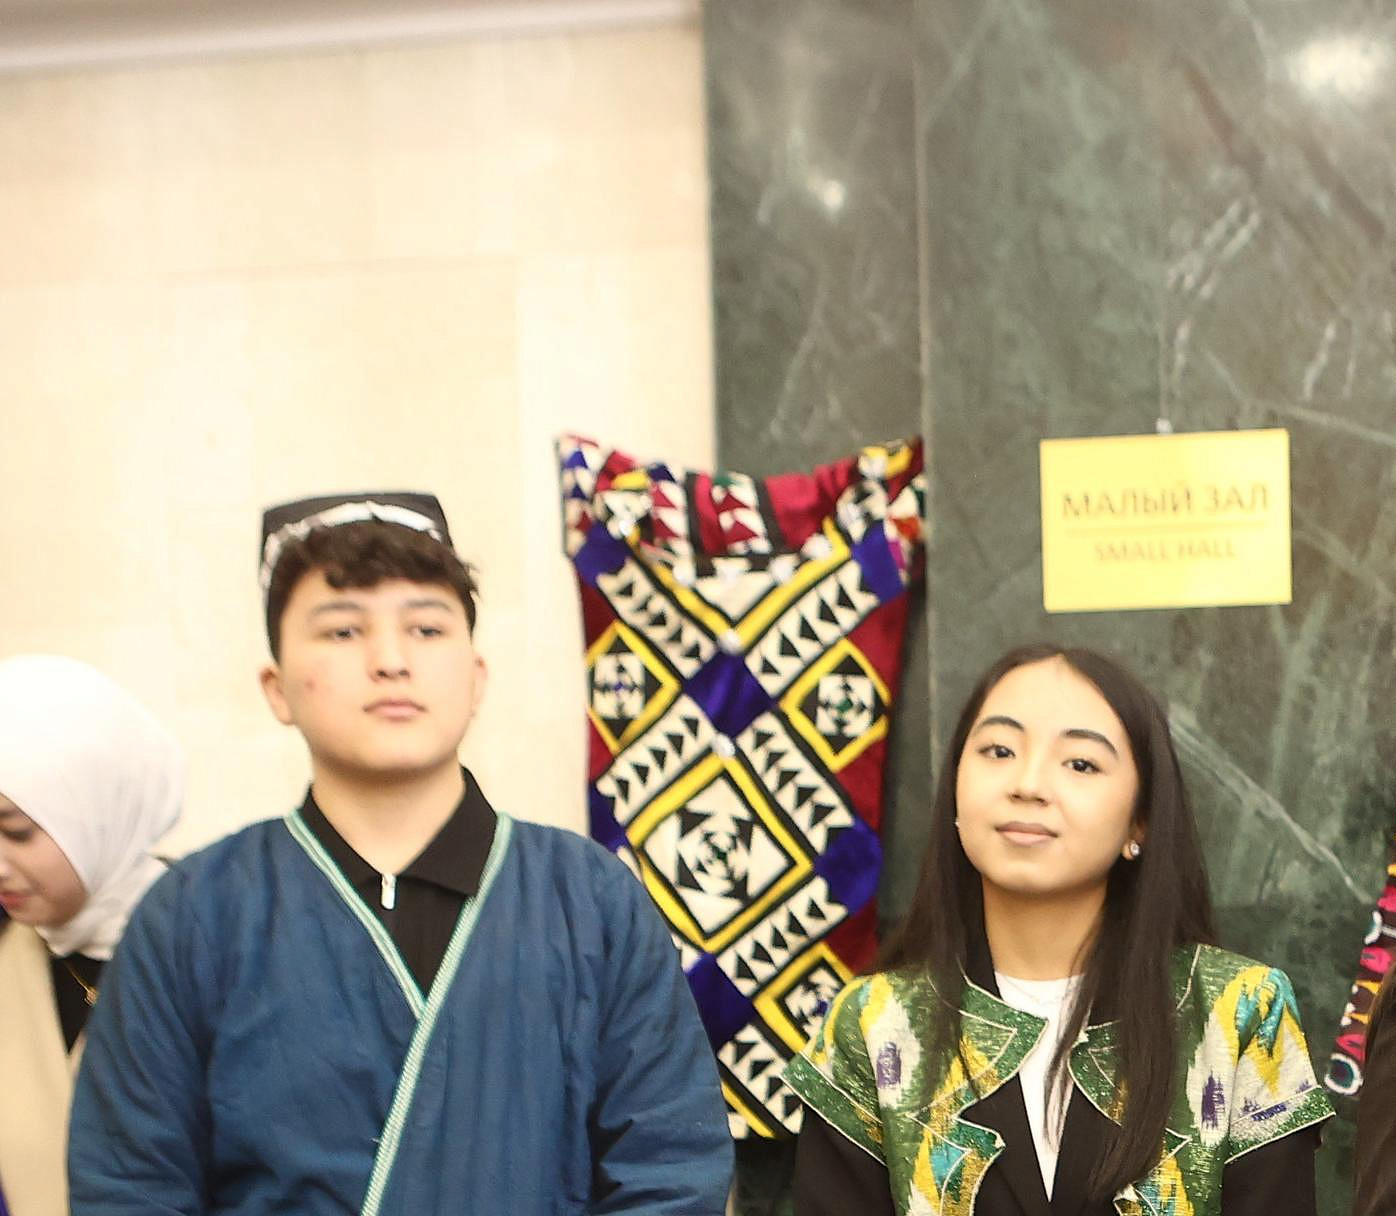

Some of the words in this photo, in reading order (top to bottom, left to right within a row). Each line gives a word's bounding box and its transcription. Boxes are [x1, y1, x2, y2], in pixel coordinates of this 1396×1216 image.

[1062, 480, 1192, 518] МАЛЫЙ
[1205, 484, 1267, 512] ЗАЛ
[1095, 542, 1168, 563] SMALL
[1178, 539, 1236, 559] HALL
